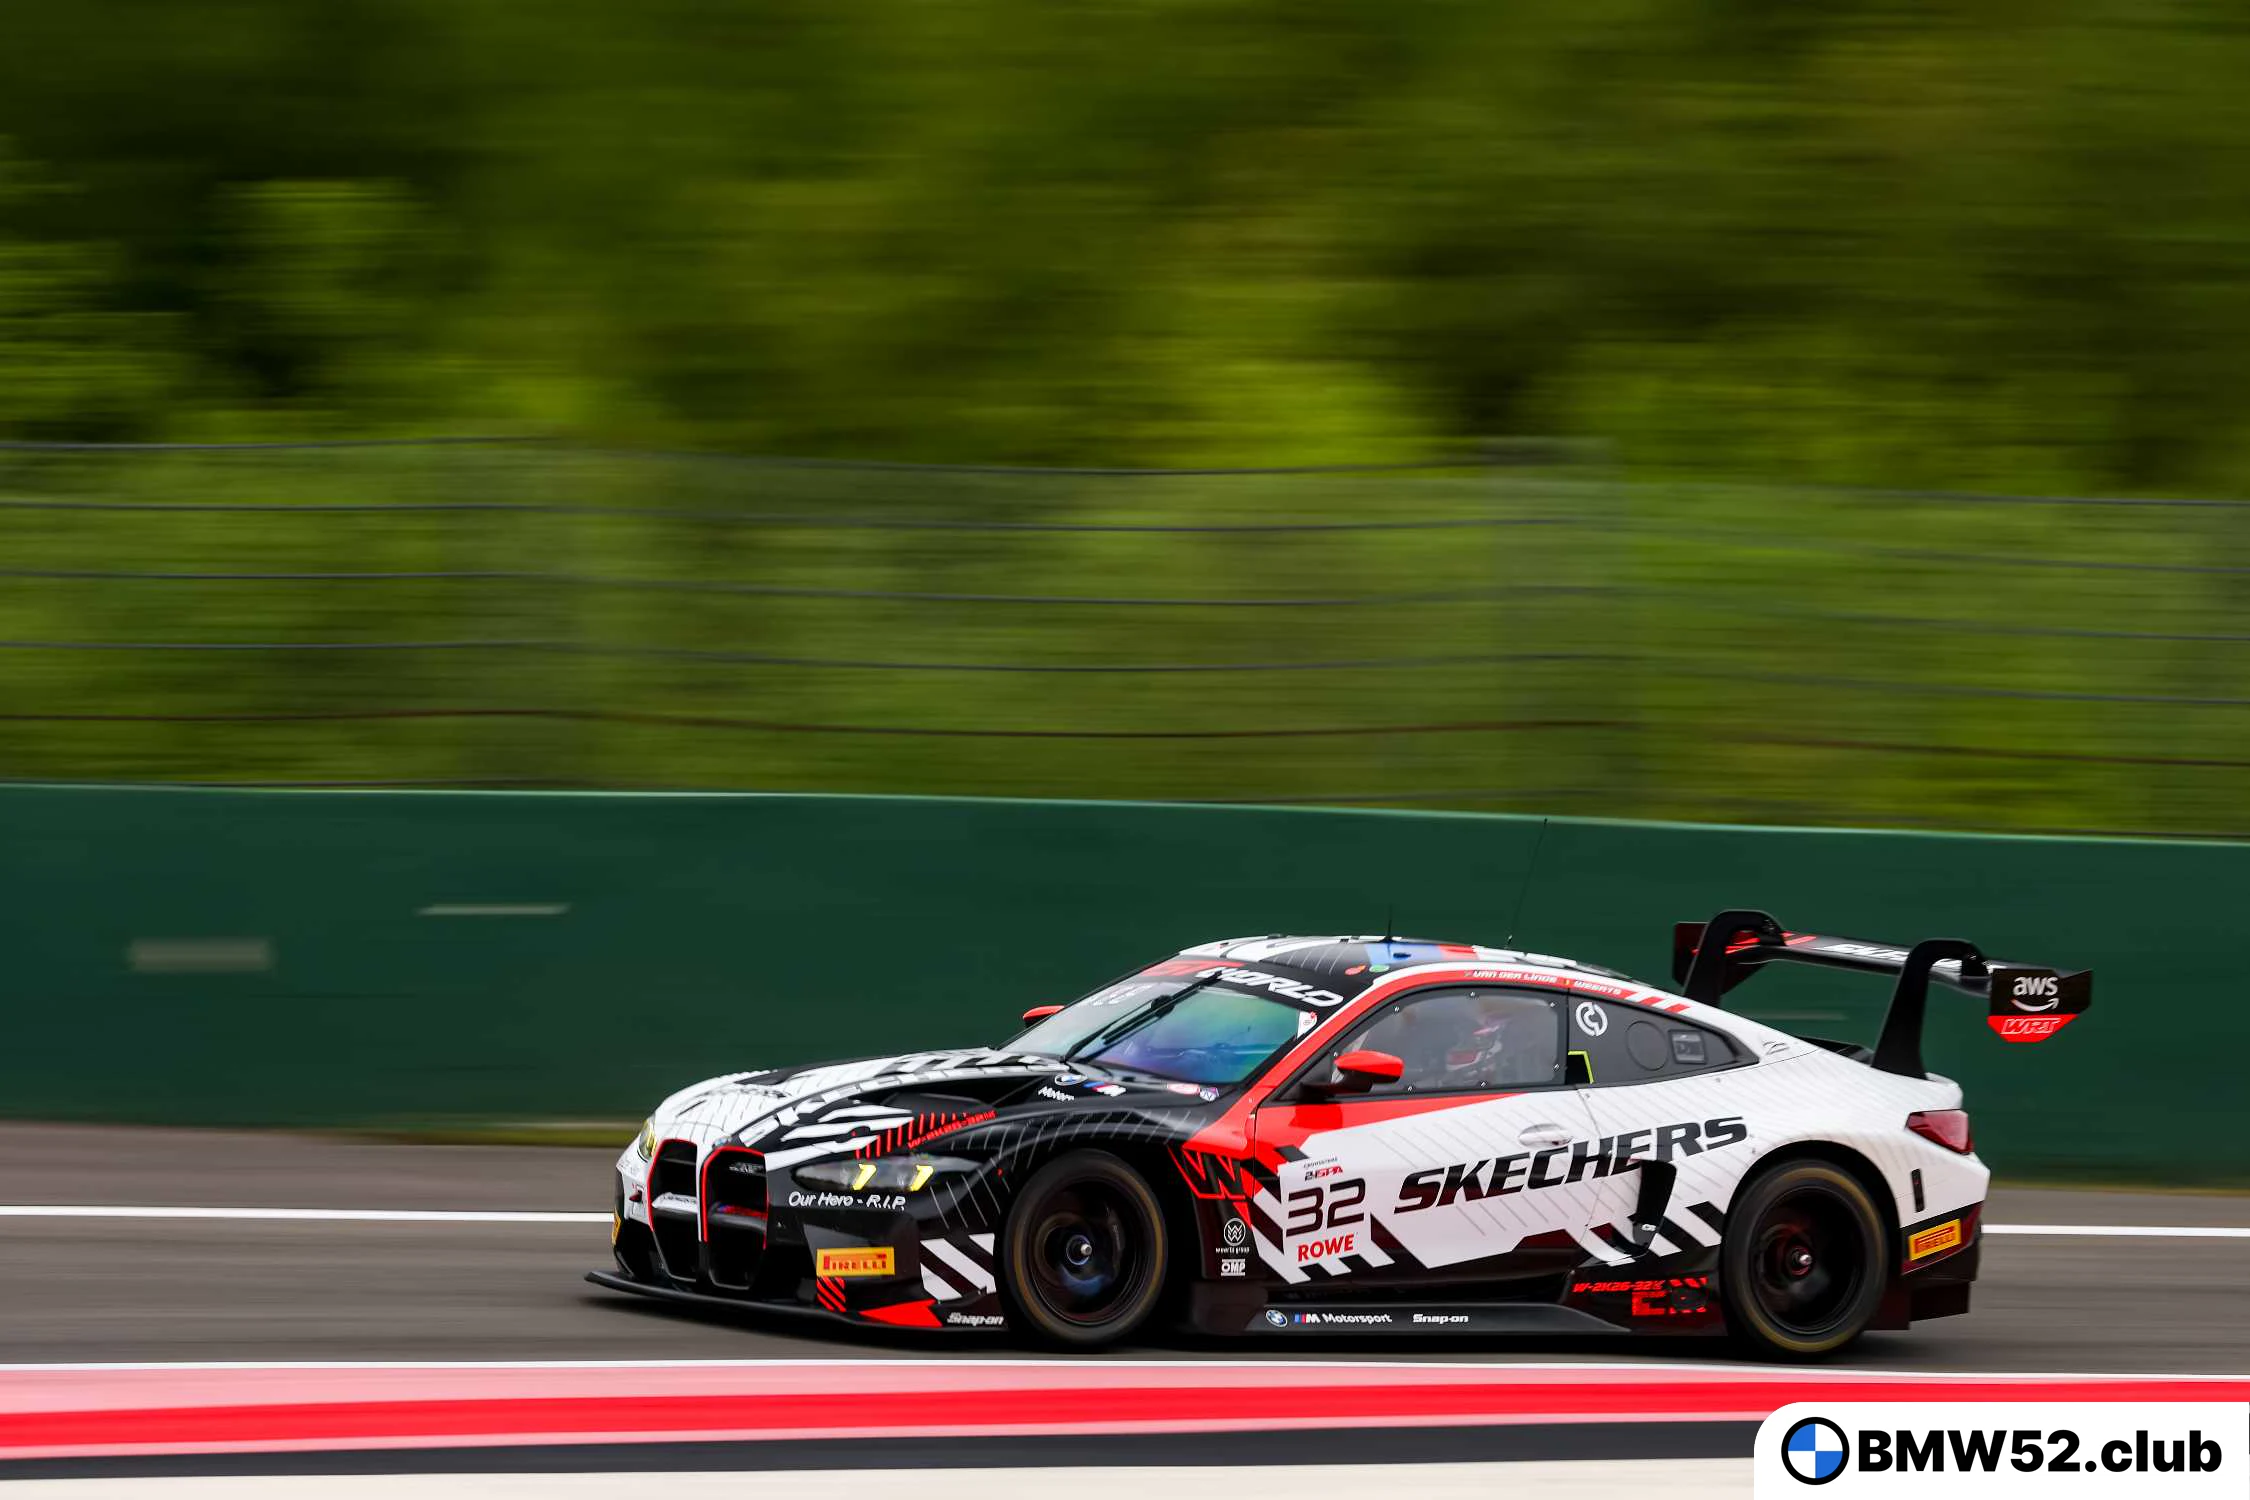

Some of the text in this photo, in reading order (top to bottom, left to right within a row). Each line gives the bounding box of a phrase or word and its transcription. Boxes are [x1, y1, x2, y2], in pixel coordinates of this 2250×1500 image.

[1195, 966, 1345, 1008] WORLD
[2012, 976, 2059, 996] aws
[2000, 1017, 2061, 1035] WRT
[1394, 1116, 1748, 1215] SKECHERS
[788, 1191, 816, 1207] Our
[817, 1192, 854, 1208] Hero
[1286, 1177, 1366, 1238] 32
[1297, 1233, 1355, 1262] ROWE
[823, 1250, 888, 1271] PIRELLI
[1221, 1262, 1246, 1273] OMP
[946, 1312, 1004, 1327] Snap-on
[1322, 1313, 1393, 1325] Motorsport
[1412, 1313, 1470, 1325] Snap-on
